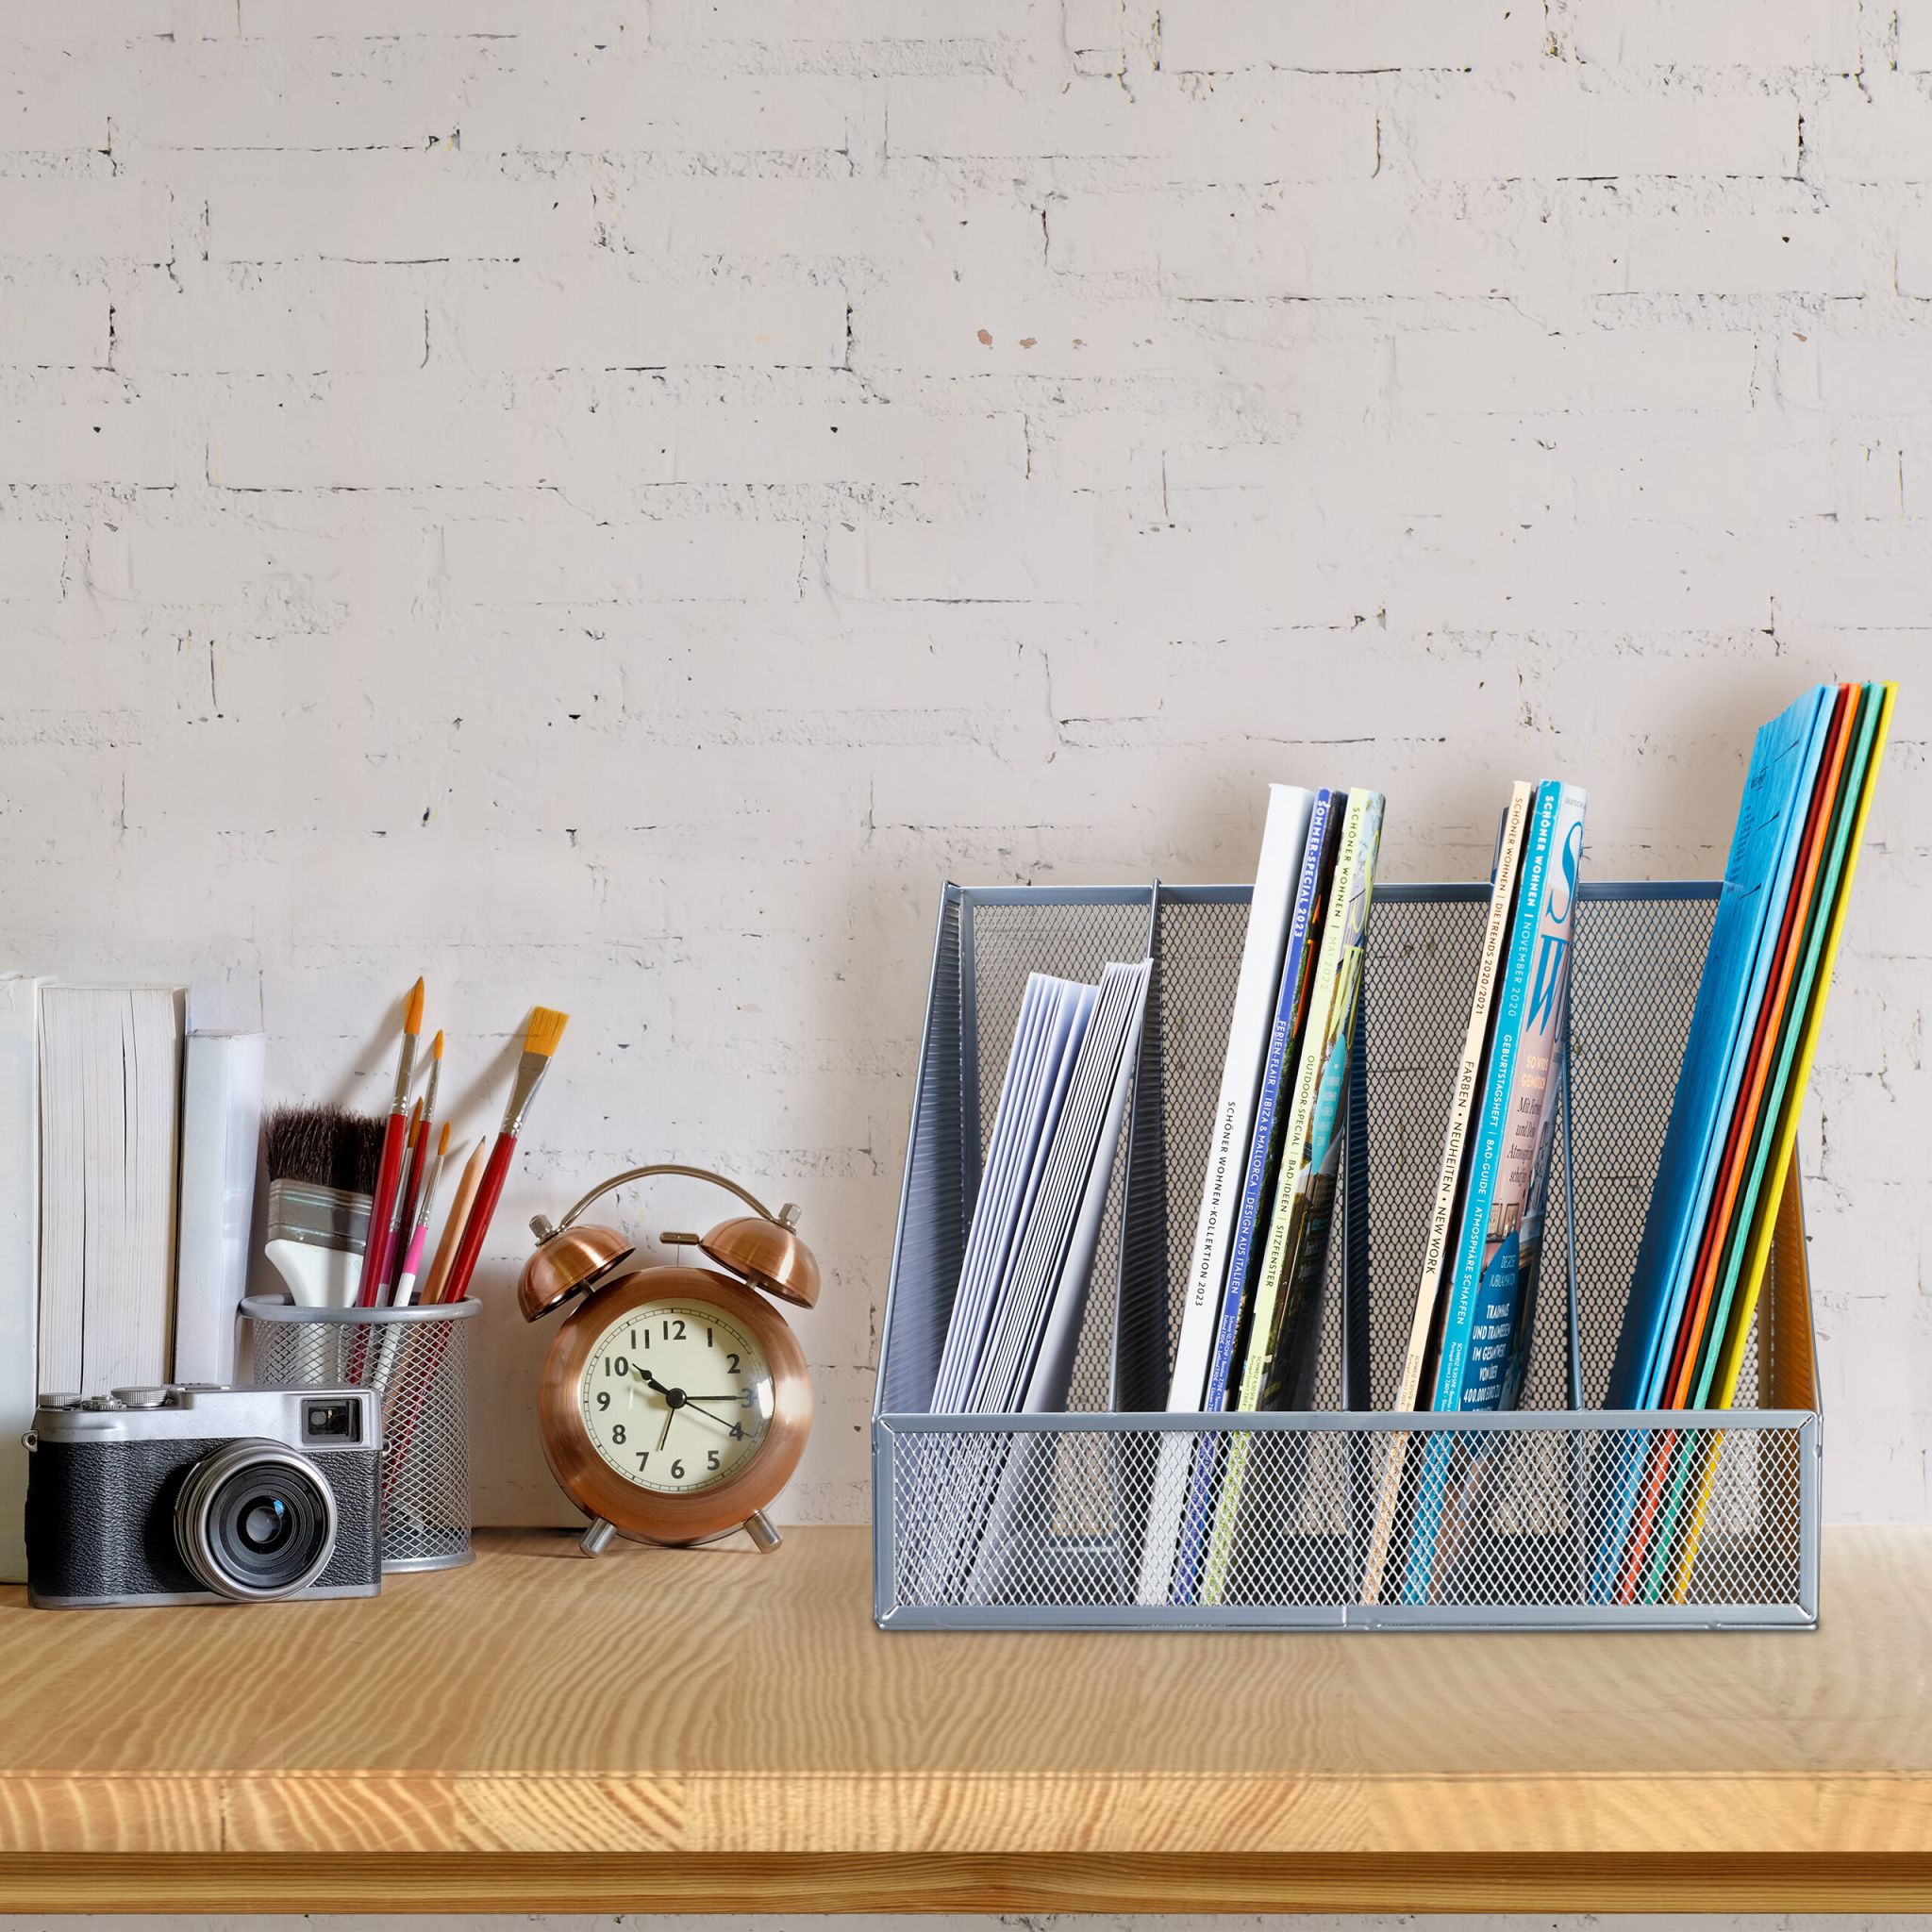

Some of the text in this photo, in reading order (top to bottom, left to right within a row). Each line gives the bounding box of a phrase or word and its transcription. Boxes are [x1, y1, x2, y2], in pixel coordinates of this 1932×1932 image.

[1294, 800, 1330, 938] SOMMER-SPECIAL 2023
[1320, 807, 1360, 991] SCHÖNER WOHNEN MAI 2022
[1475, 797, 1523, 1015] SCHÖNER WOHNEN DIE TRENDS 2020/2021
[1507, 795, 1555, 1017] SCHÖNER WOHNEN NOVEMBER 2020
[1267, 1020, 1287, 1086] FERIEN-FLAIR
[1259, 1097, 1273, 1123] IBIZA
[1249, 1134, 1267, 1188] MALLORCA
[1265, 1055, 1315, 1288] OUTDOOR-SPECIAL BAD-IDEEN SITZFENSTER
[1425, 1060, 1474, 1274] FARBEN NEUHEITEN NEW WORK
[1457, 1034, 1512, 1325] GEBURTSTAGSHEFT BAD-GUIDE ATMOSPHÄRE SCHAFFEN
[1195, 1101, 1236, 1307] SCHÖNER WOHNEN-KOLLEKTION 2023
[1240, 1194, 1255, 1234] DESIGN
[1237, 1236, 1248, 1256] AUS
[1230, 1258, 1245, 1294] ITALIEN
[630, 1329, 650, 1349] 11
[662, 1320, 687, 1341] 12
[707, 1327, 713, 1347] 1
[1472, 1325, 1488, 1341] UND
[725, 1353, 741, 1374] 2
[1472, 1346, 1482, 1361] IM
[605, 1356, 629, 1376] 10
[596, 1391, 611, 1411] 9
[741, 1388, 756, 1408] 3
[611, 1424, 626, 1445] 8
[728, 1421, 743, 1441] 4
[636, 1451, 650, 1472] 7
[671, 1458, 685, 1479] 6
[707, 1449, 721, 1471] 5
